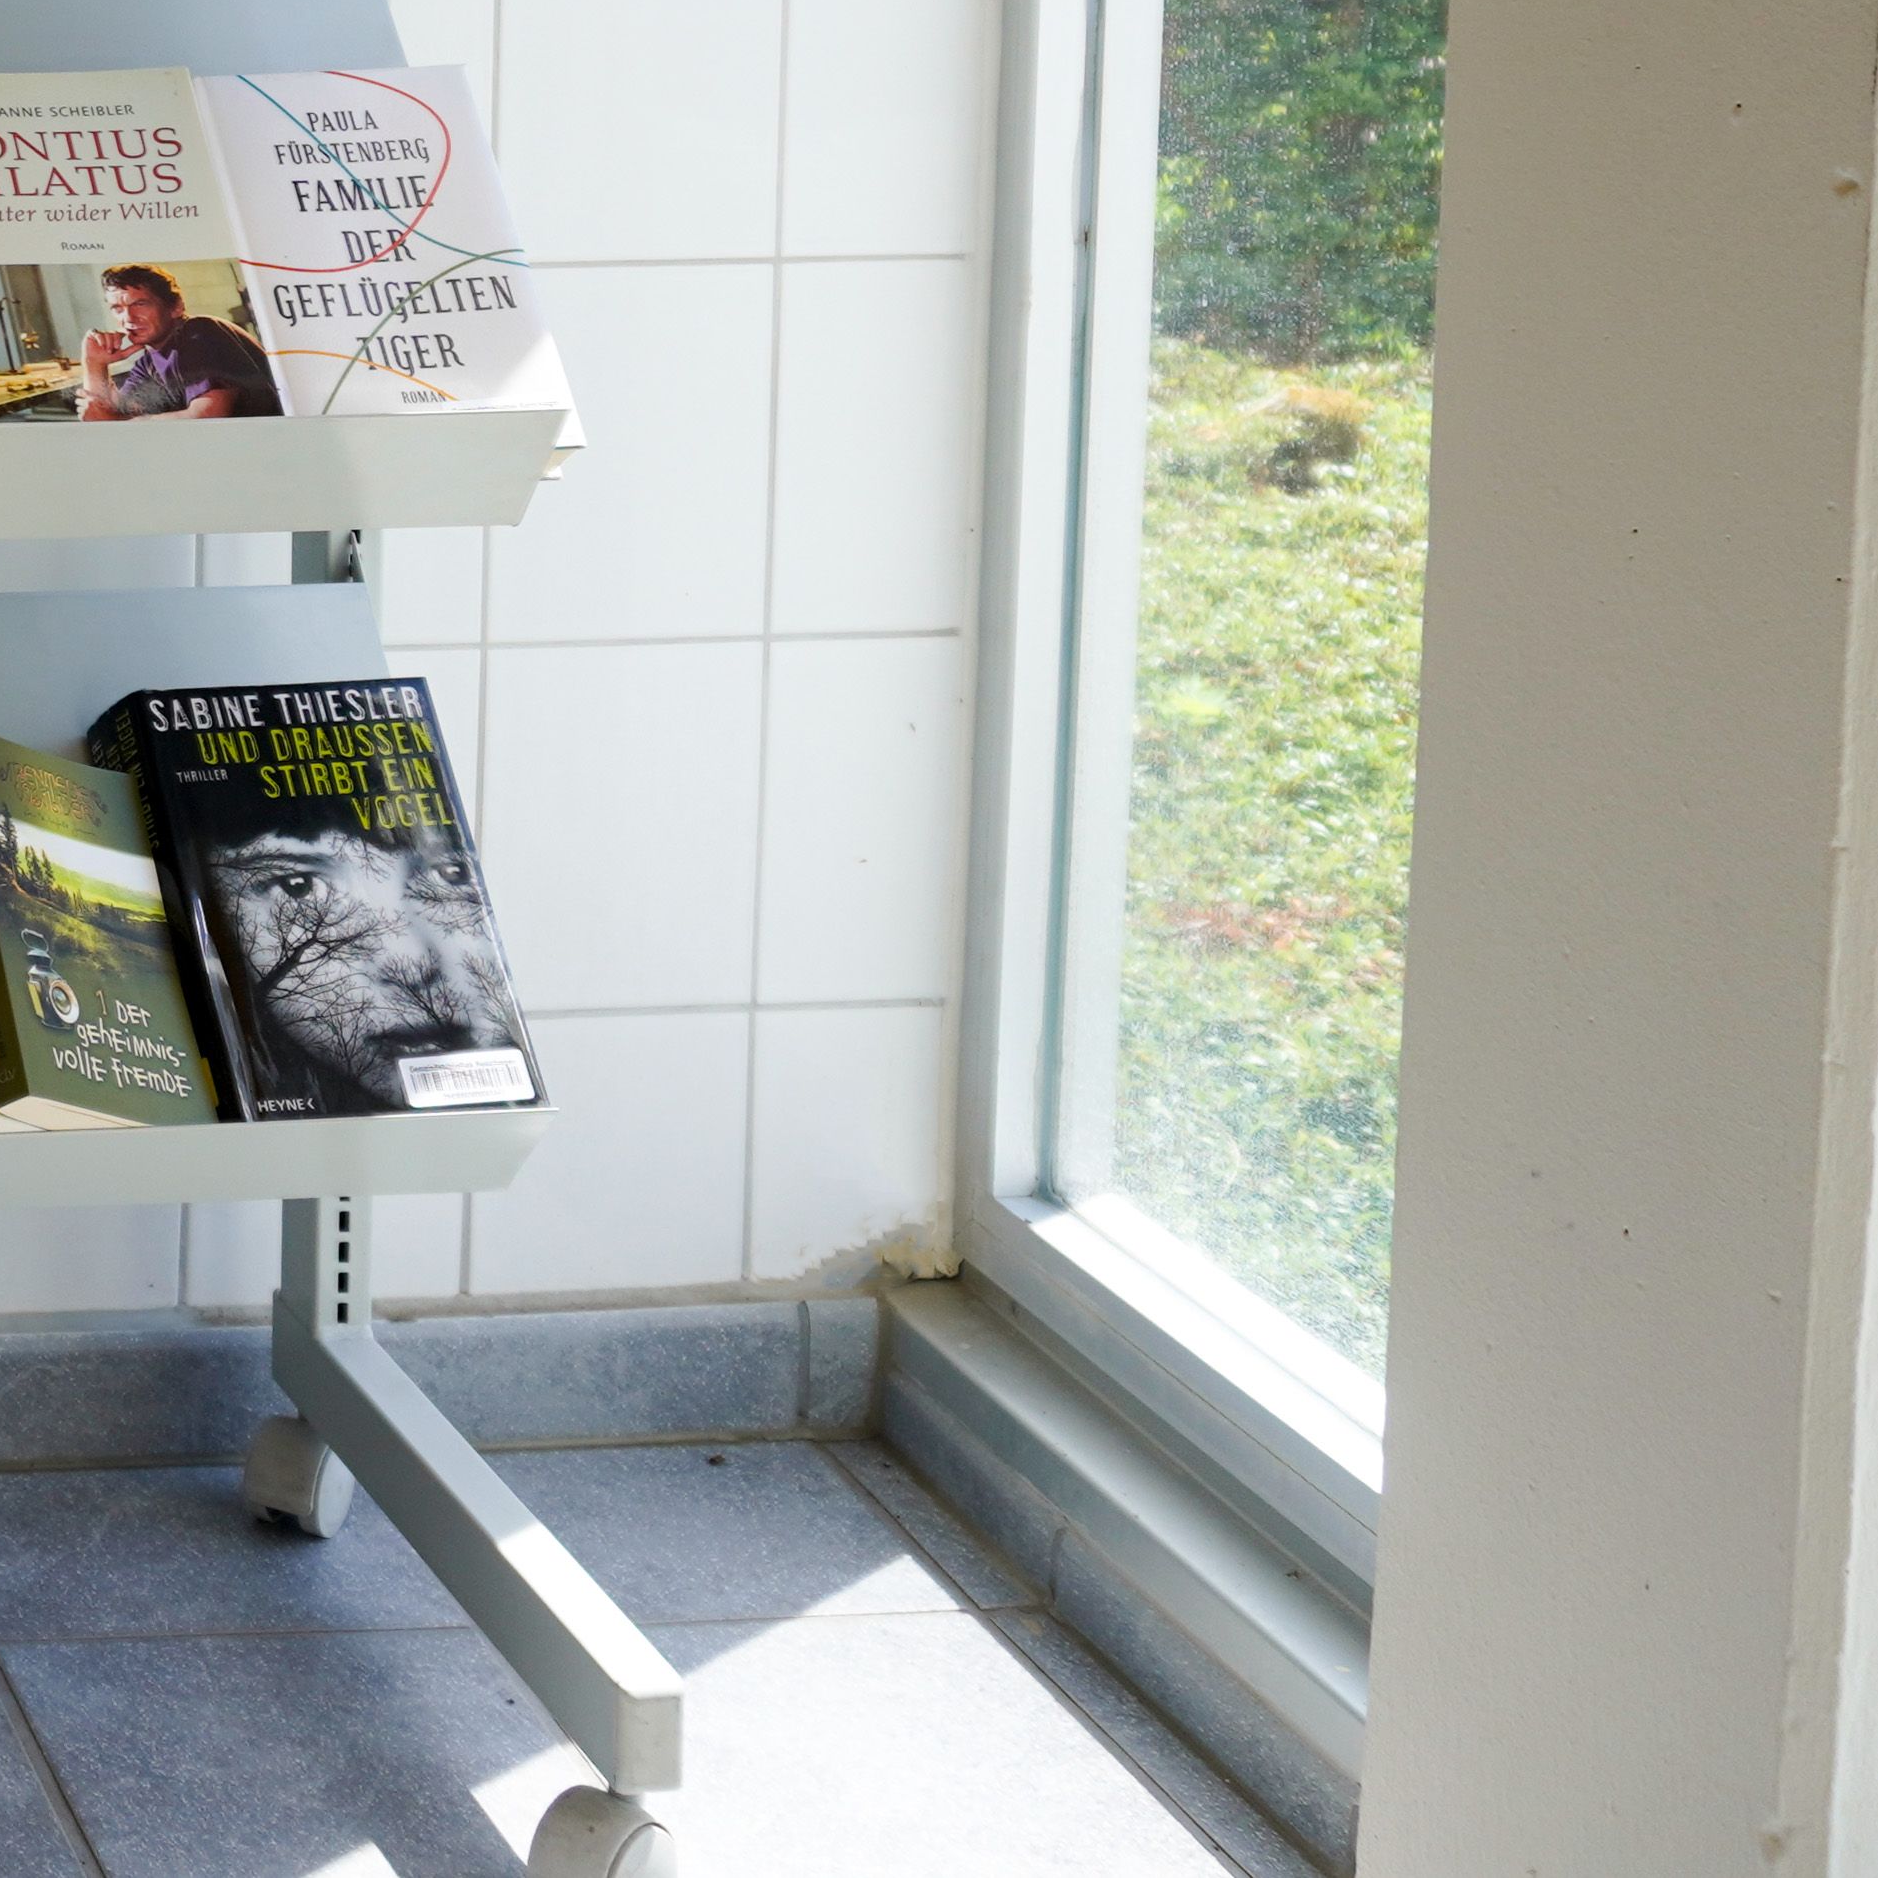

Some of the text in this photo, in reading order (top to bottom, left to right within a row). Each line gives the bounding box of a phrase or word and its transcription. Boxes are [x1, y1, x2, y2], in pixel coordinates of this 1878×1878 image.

[49, 103, 135, 117] SCHEIBLER
[306, 110, 378, 132] PAULA
[274, 136, 429, 166] FÜRSTENBERG
[45, 201, 113, 222] wider
[121, 199, 199, 219] Willen
[292, 175, 433, 212] FAMILIE
[342, 227, 416, 264] DER
[274, 274, 517, 326] GEFLÜGELTEN
[356, 332, 466, 375] TIGER
[401, 388, 446, 403] ROMAN
[149, 686, 424, 732] SABINE THIESLER
[196, 722, 435, 766] UND DRAUSSEN
[175, 769, 228, 784] THRILLER
[259, 757, 436, 799] STIRBT EIN
[351, 793, 456, 831] VOGEL
